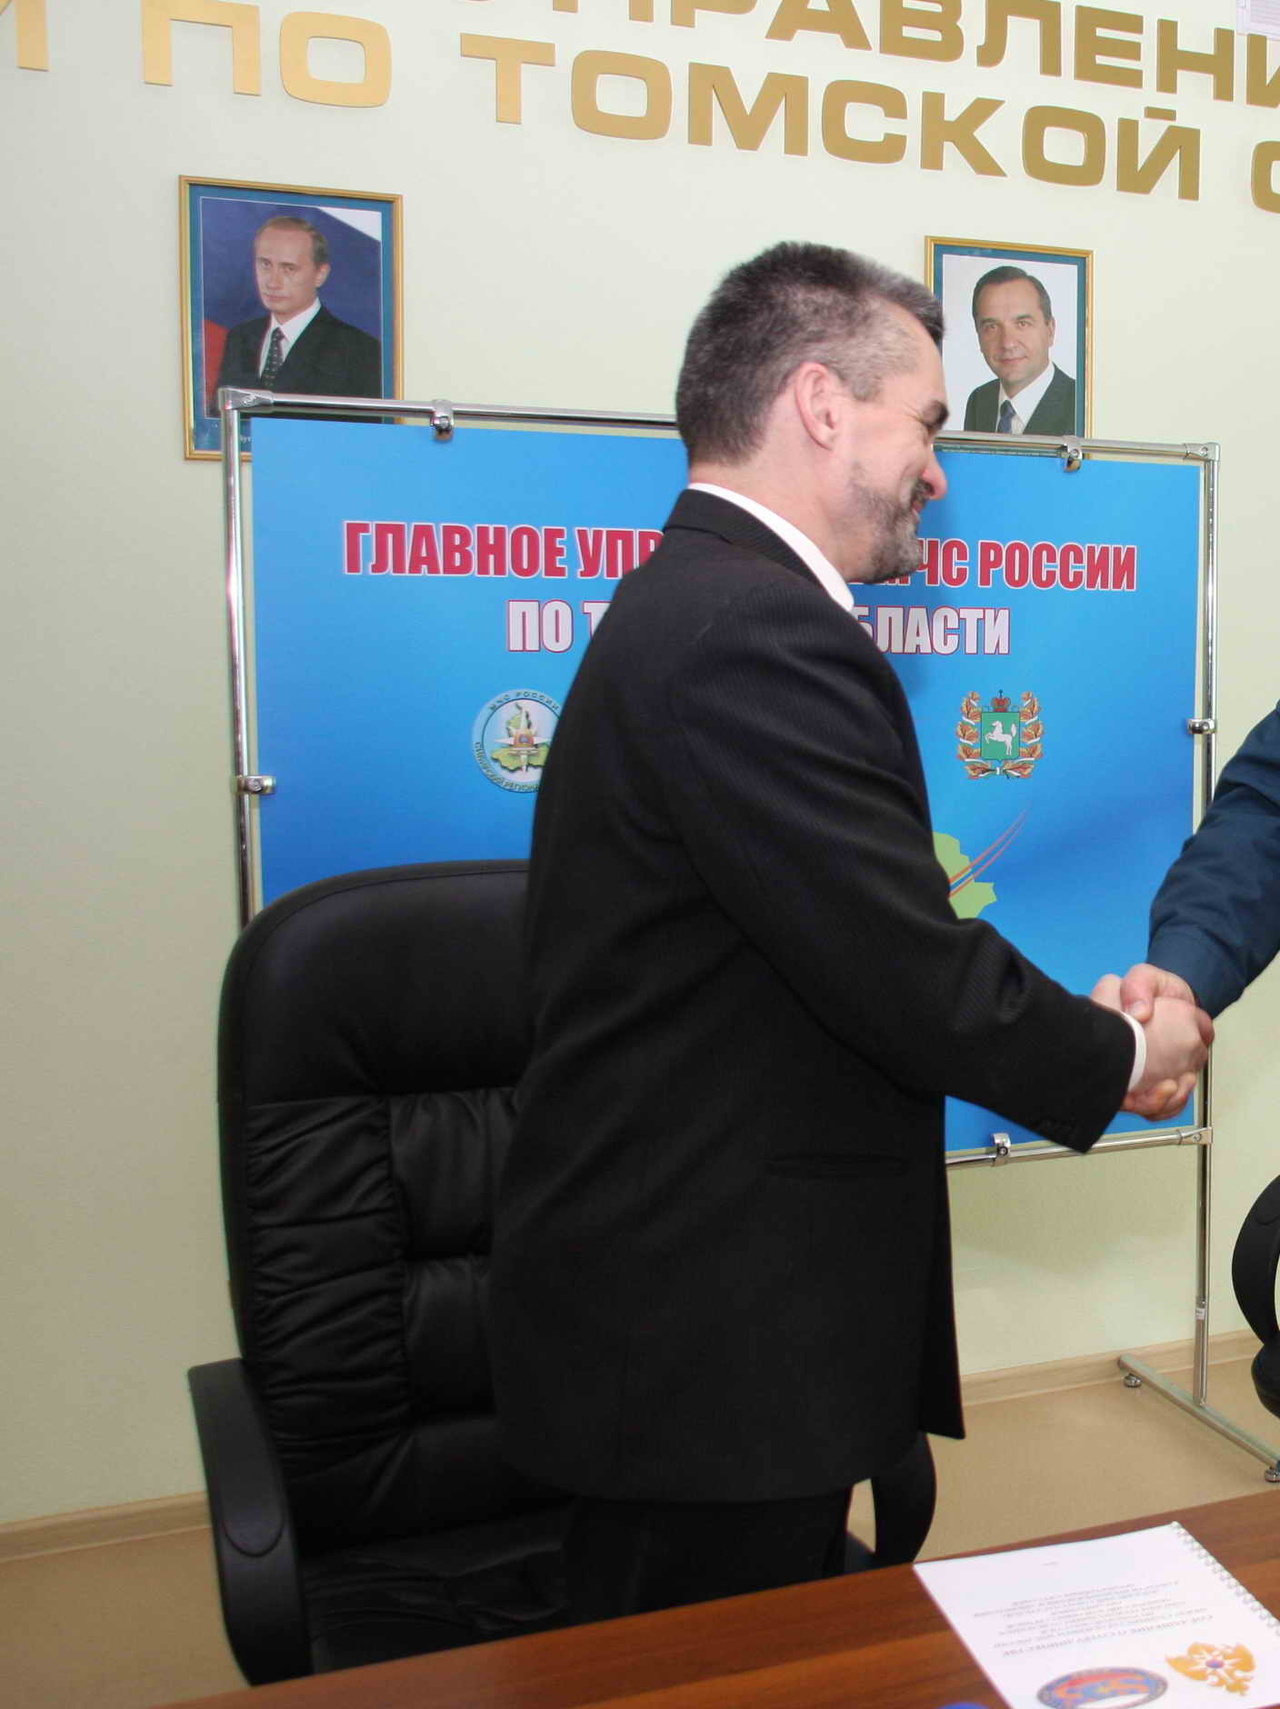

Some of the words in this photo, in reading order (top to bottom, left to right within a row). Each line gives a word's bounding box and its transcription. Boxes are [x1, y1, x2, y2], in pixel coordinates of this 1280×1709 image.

[140, 0, 392, 107] ПО
[460, 33, 1201, 201] ТОМСКОЙ
[344, 521, 567, 579] ГЛАВНОЕ
[886, 538, 970, 588] ЧС
[978, 540, 1137, 591] РОССИИ
[507, 599, 573, 653] ПО
